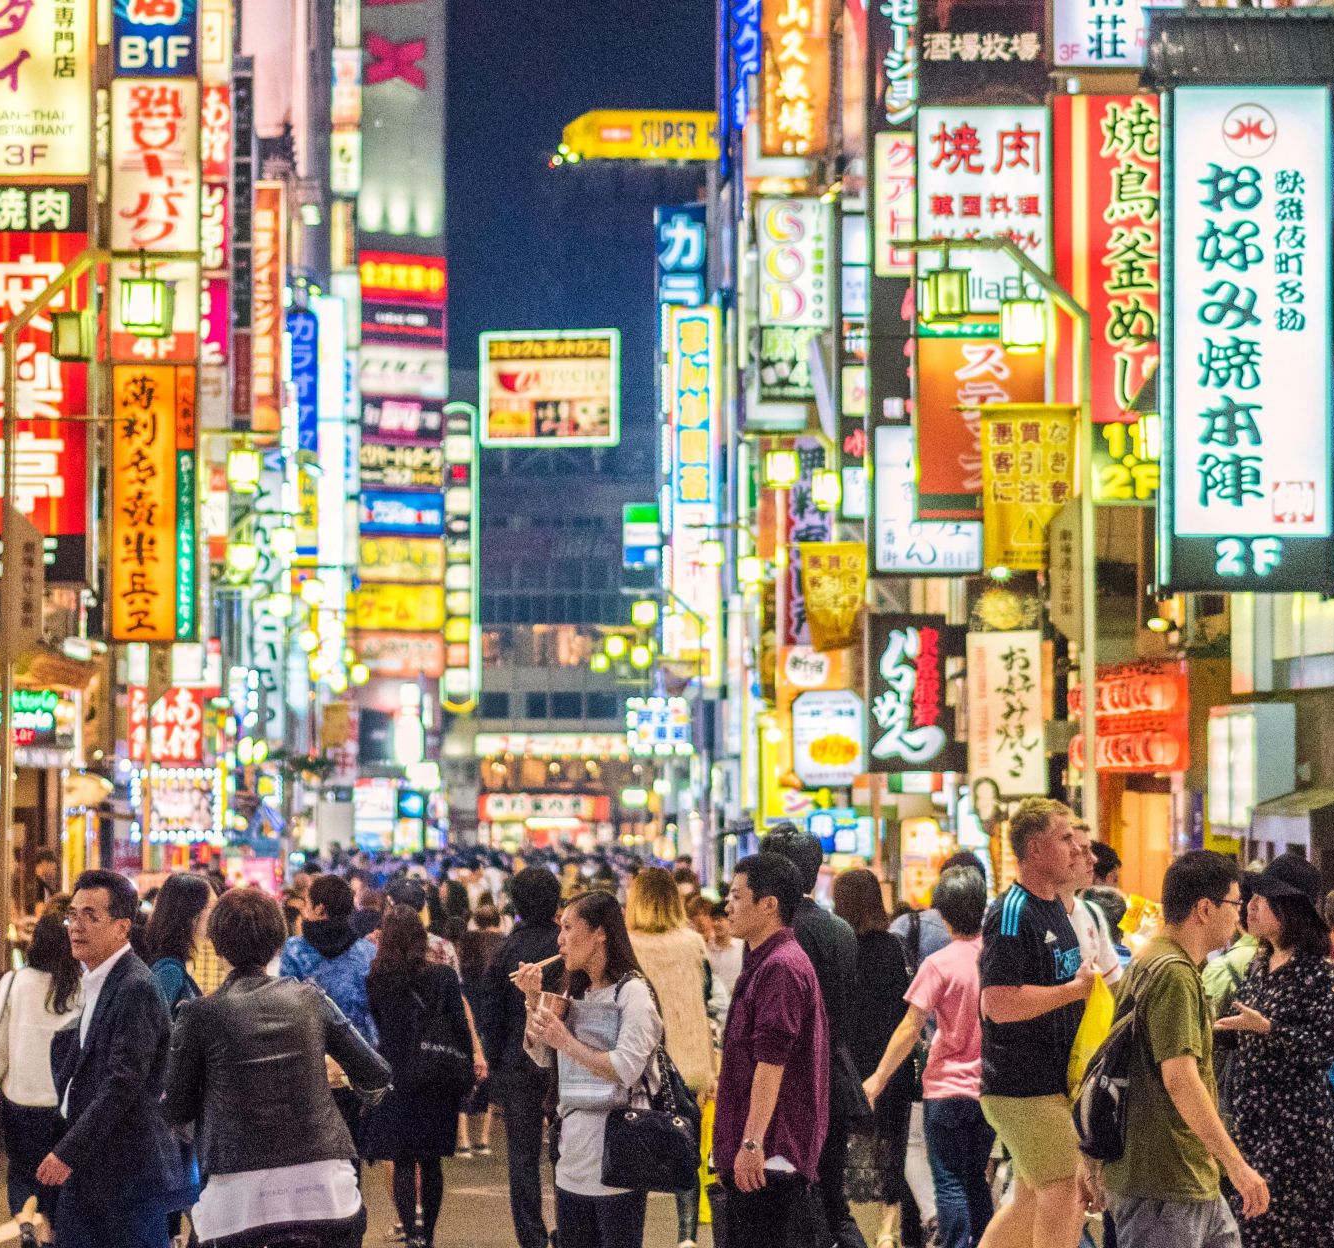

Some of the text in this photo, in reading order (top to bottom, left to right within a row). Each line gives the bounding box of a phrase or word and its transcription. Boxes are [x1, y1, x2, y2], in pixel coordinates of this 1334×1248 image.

[53, 0, 76, 78] 専門店
[1086, 0, 1126, 60] 荘
[119, 36, 192, 69] B1F
[1059, 43, 1080, 61] 3F
[640, 120, 697, 149] SUPER
[5, 144, 48, 166] 3F
[1099, 102, 1159, 412] 焼鳥釜めし
[1273, 168, 1306, 332] 歌舞伎町名物
[1197, 162, 1265, 508] お好み焼本陣
[989, 420, 1070, 446] 悪質な
[990, 450, 1068, 476] 客引き
[1100, 463, 1159, 500] 2F
[991, 479, 1070, 506] に注意
[1215, 537, 1281, 577] 2F
[995, 646, 1039, 778] お好み焼き
